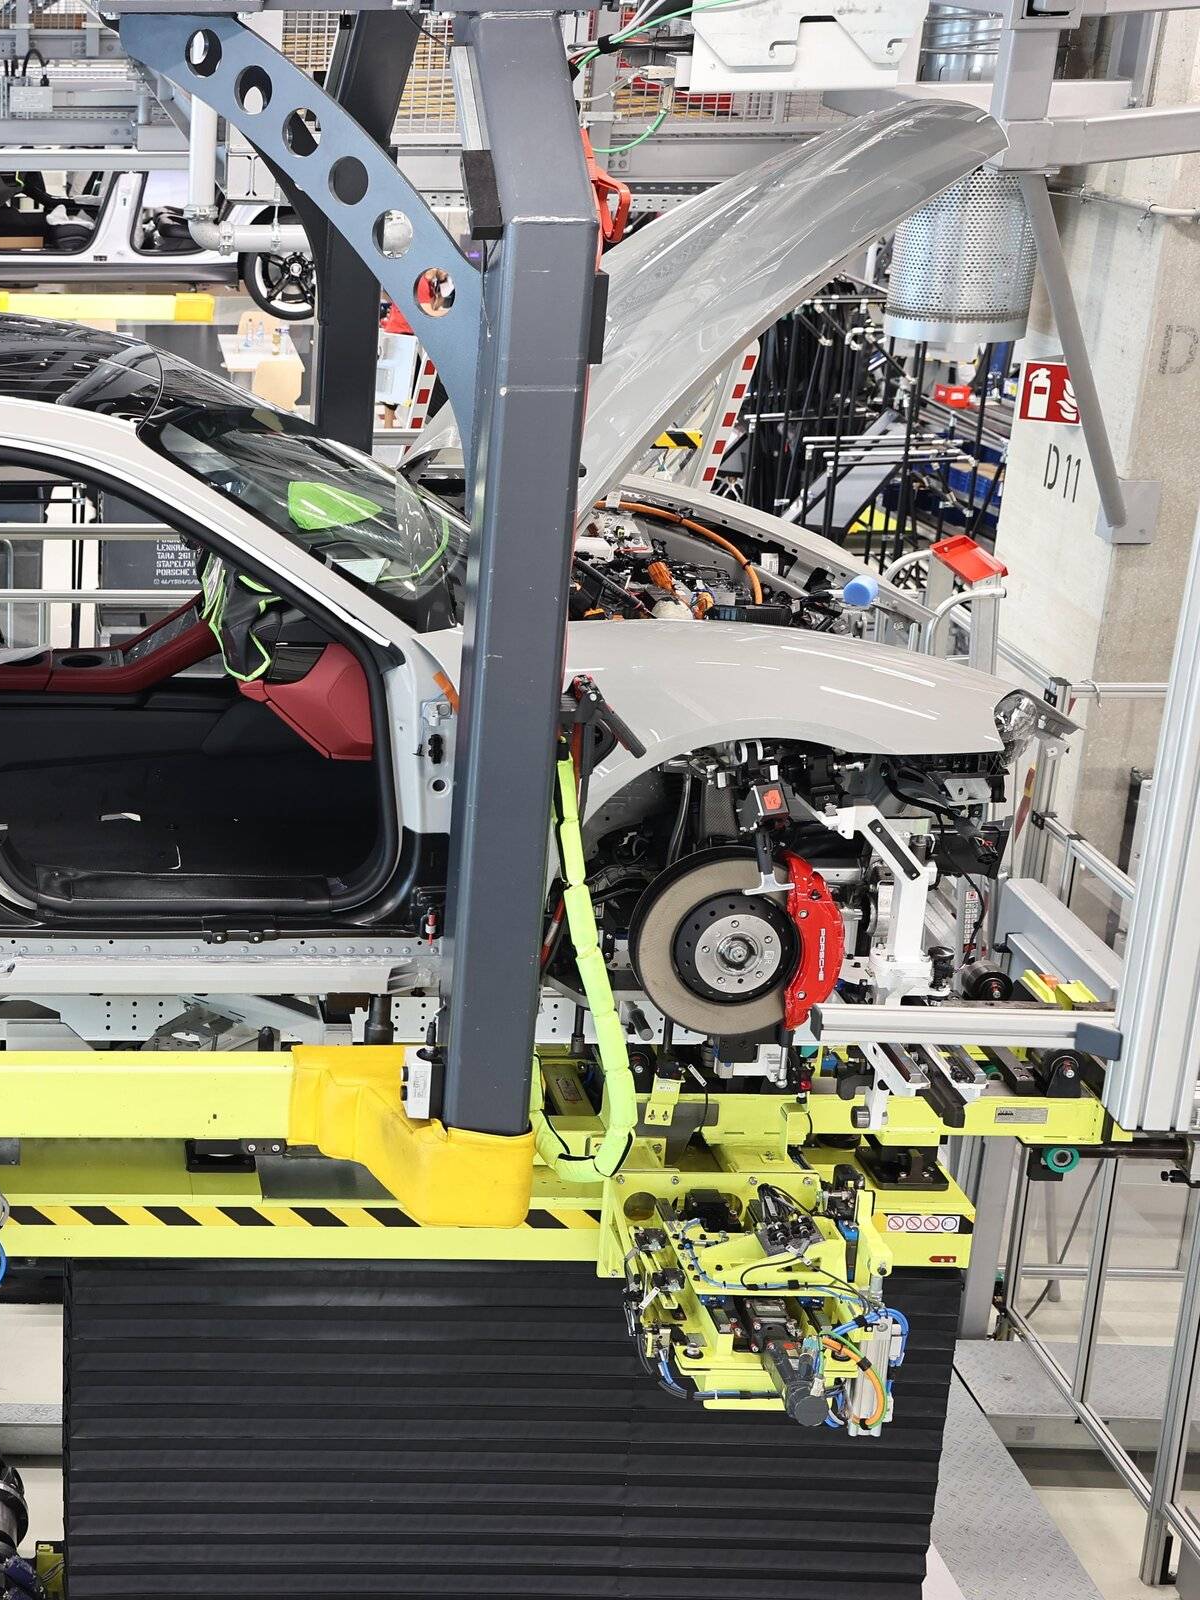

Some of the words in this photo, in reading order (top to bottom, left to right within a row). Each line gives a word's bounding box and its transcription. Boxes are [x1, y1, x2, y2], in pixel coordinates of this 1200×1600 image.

[1043, 443, 1081, 503] D11
[156, 552, 175, 560] TARA
[155, 568, 190, 576] PORSCHE
[818, 928, 826, 982] PORSCHE
